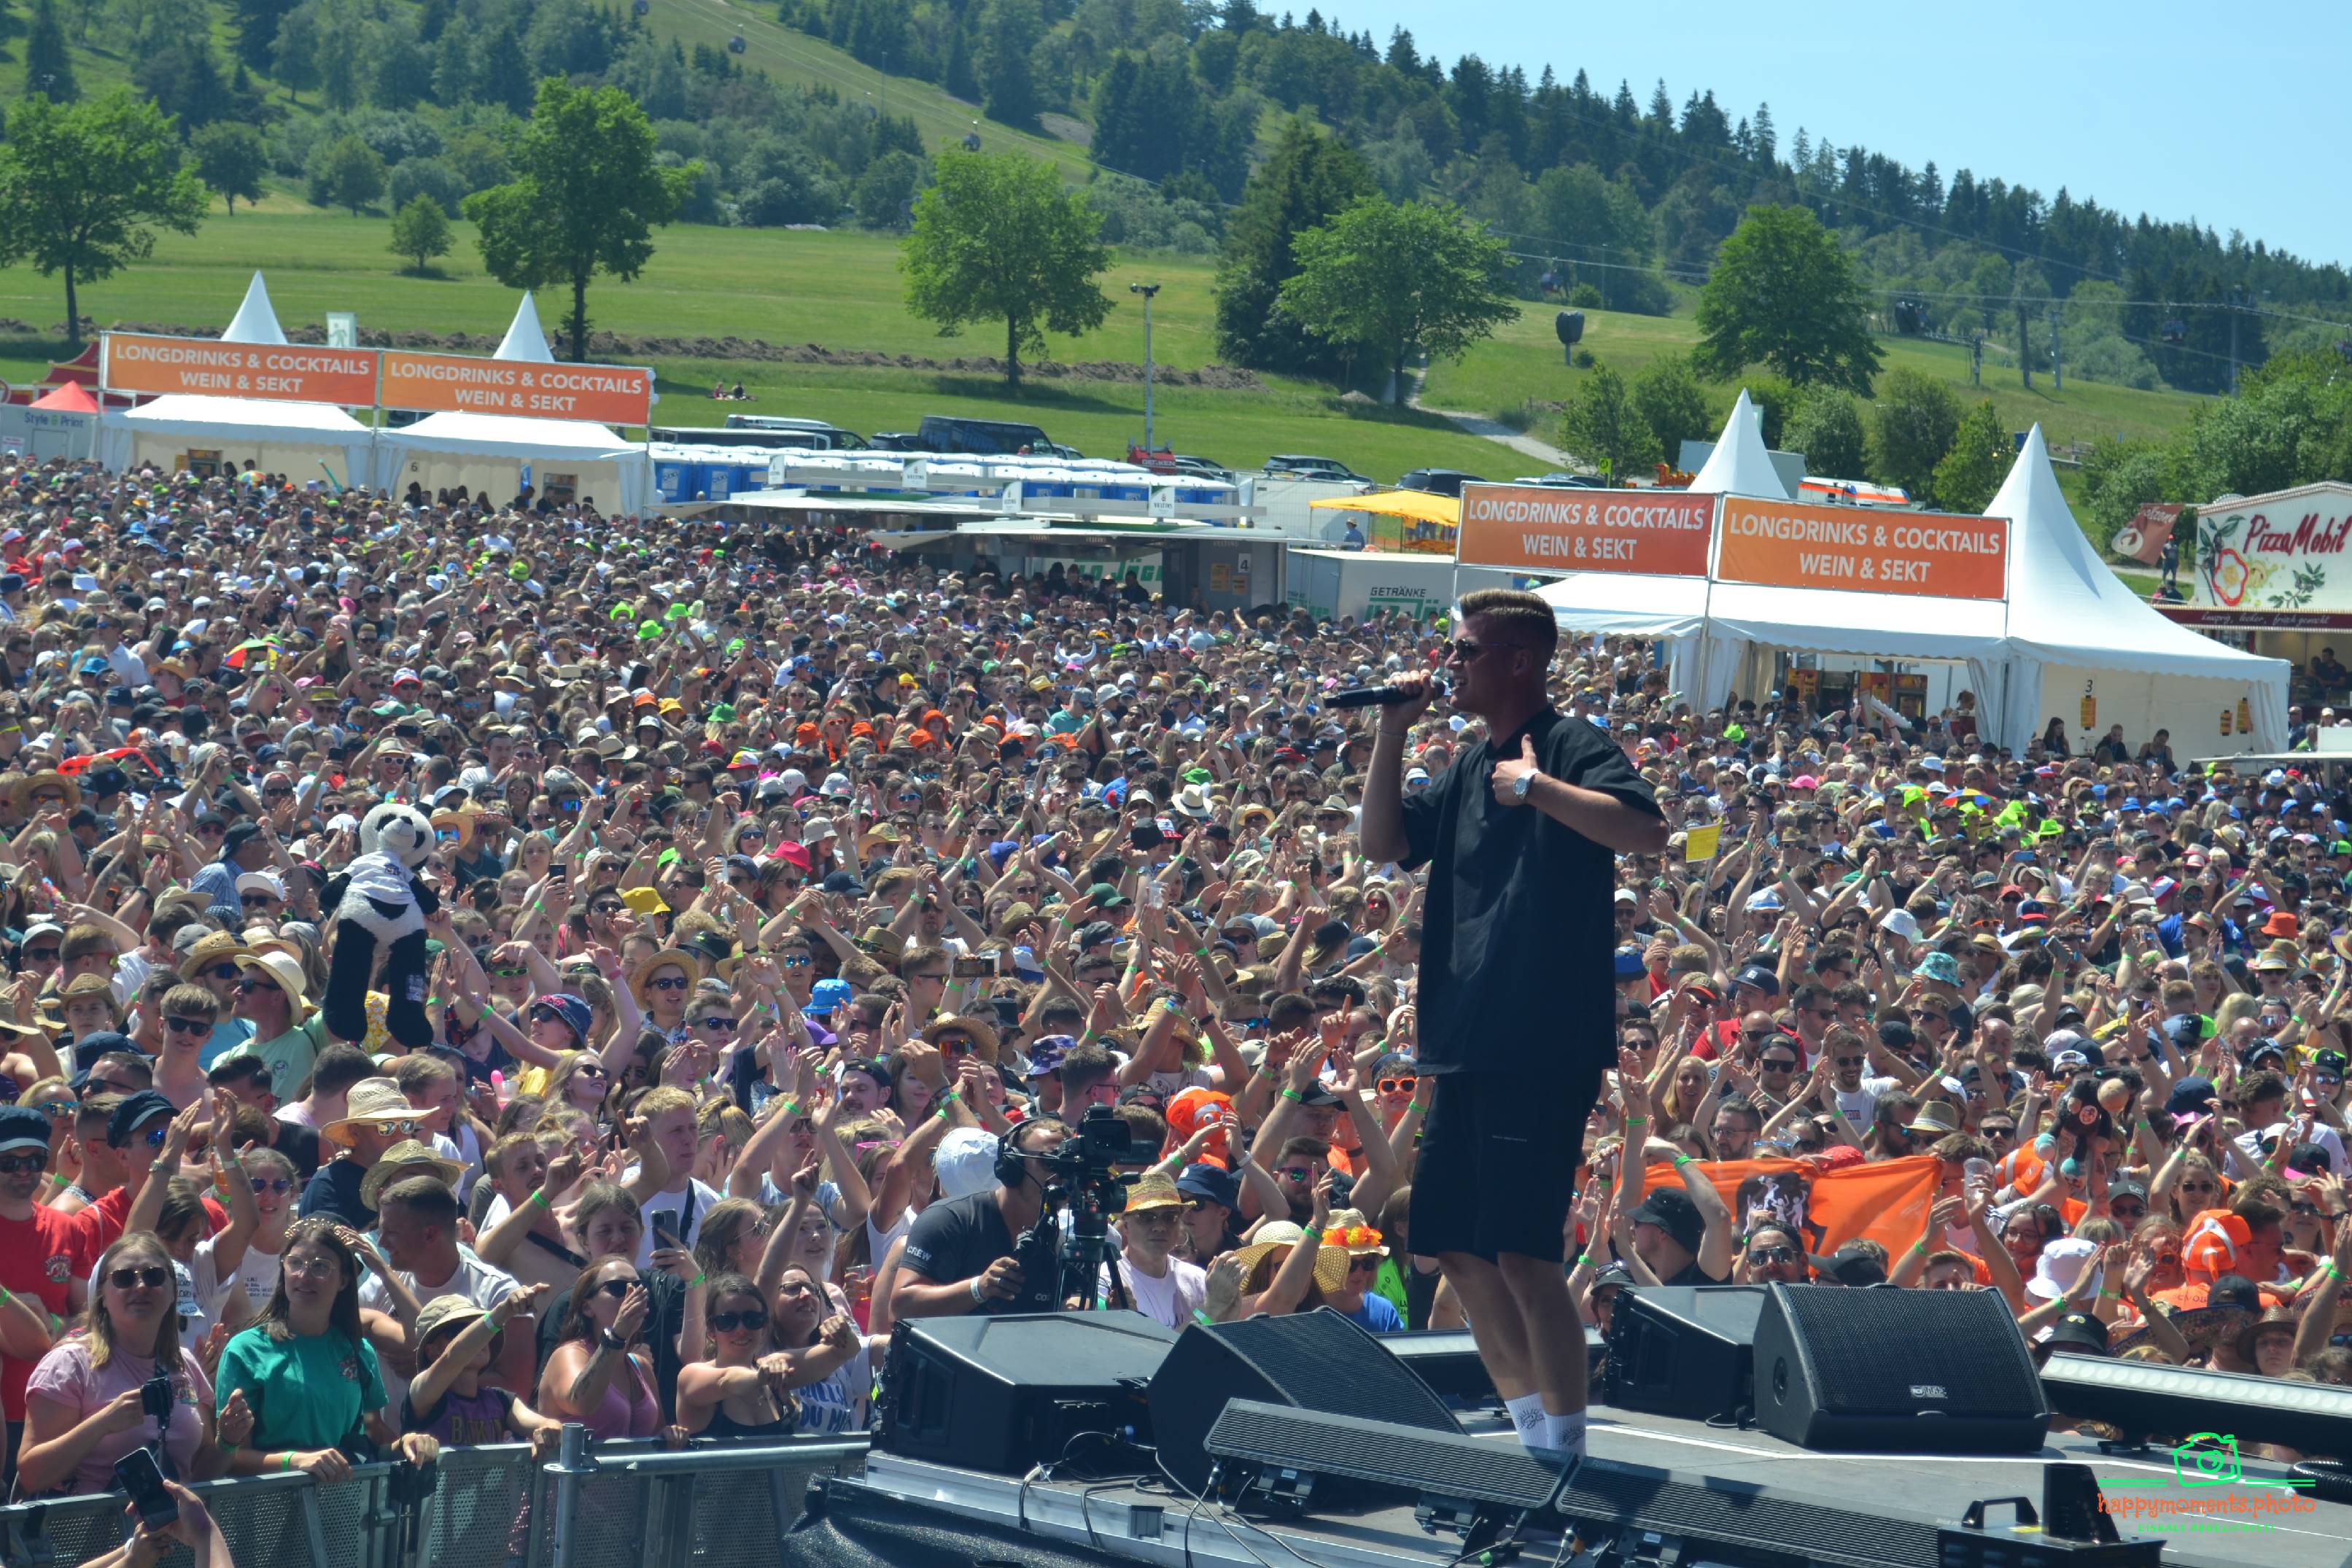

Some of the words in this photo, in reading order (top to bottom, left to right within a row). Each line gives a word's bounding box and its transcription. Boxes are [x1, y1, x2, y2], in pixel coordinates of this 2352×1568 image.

[116, 344, 242, 366] LONGDRINKS
[247, 354, 261, 369] &
[266, 354, 370, 375] COCKTAILS
[180, 371, 231, 389] WEIN
[236, 375, 250, 390] &
[256, 376, 303, 392] SEKT
[391, 362, 516, 385] LONGDRINKS
[521, 372, 535, 387] &
[540, 373, 643, 395] COCKTAILS
[454, 389, 505, 406] WEIN
[511, 393, 524, 408] &
[529, 394, 576, 411] SEKT
[24, 411, 48, 426] Style
[61, 415, 84, 427] Print
[411, 461, 419, 473] 6
[1468, 499, 1582, 525] LONGDRINKS
[1586, 504, 1599, 526] &
[1604, 505, 1705, 530] COCKTAILS
[1729, 512, 1868, 546] LONGDRINKS
[1873, 525, 1887, 548] &
[1893, 526, 2000, 555] COCKTAILS
[1522, 534, 1569, 556] WEIN
[1573, 536, 1587, 559] &
[1592, 537, 1637, 560] SEKT
[1240, 559, 1249, 571] 4
[1799, 552, 1855, 578] WEIN
[1859, 557, 1874, 579] &
[1880, 559, 1931, 582] SEKT
[1370, 586, 1427, 598] GETRÄNKE
[2085, 679, 2093, 693] 3
[907, 1245, 932, 1262] CREW
